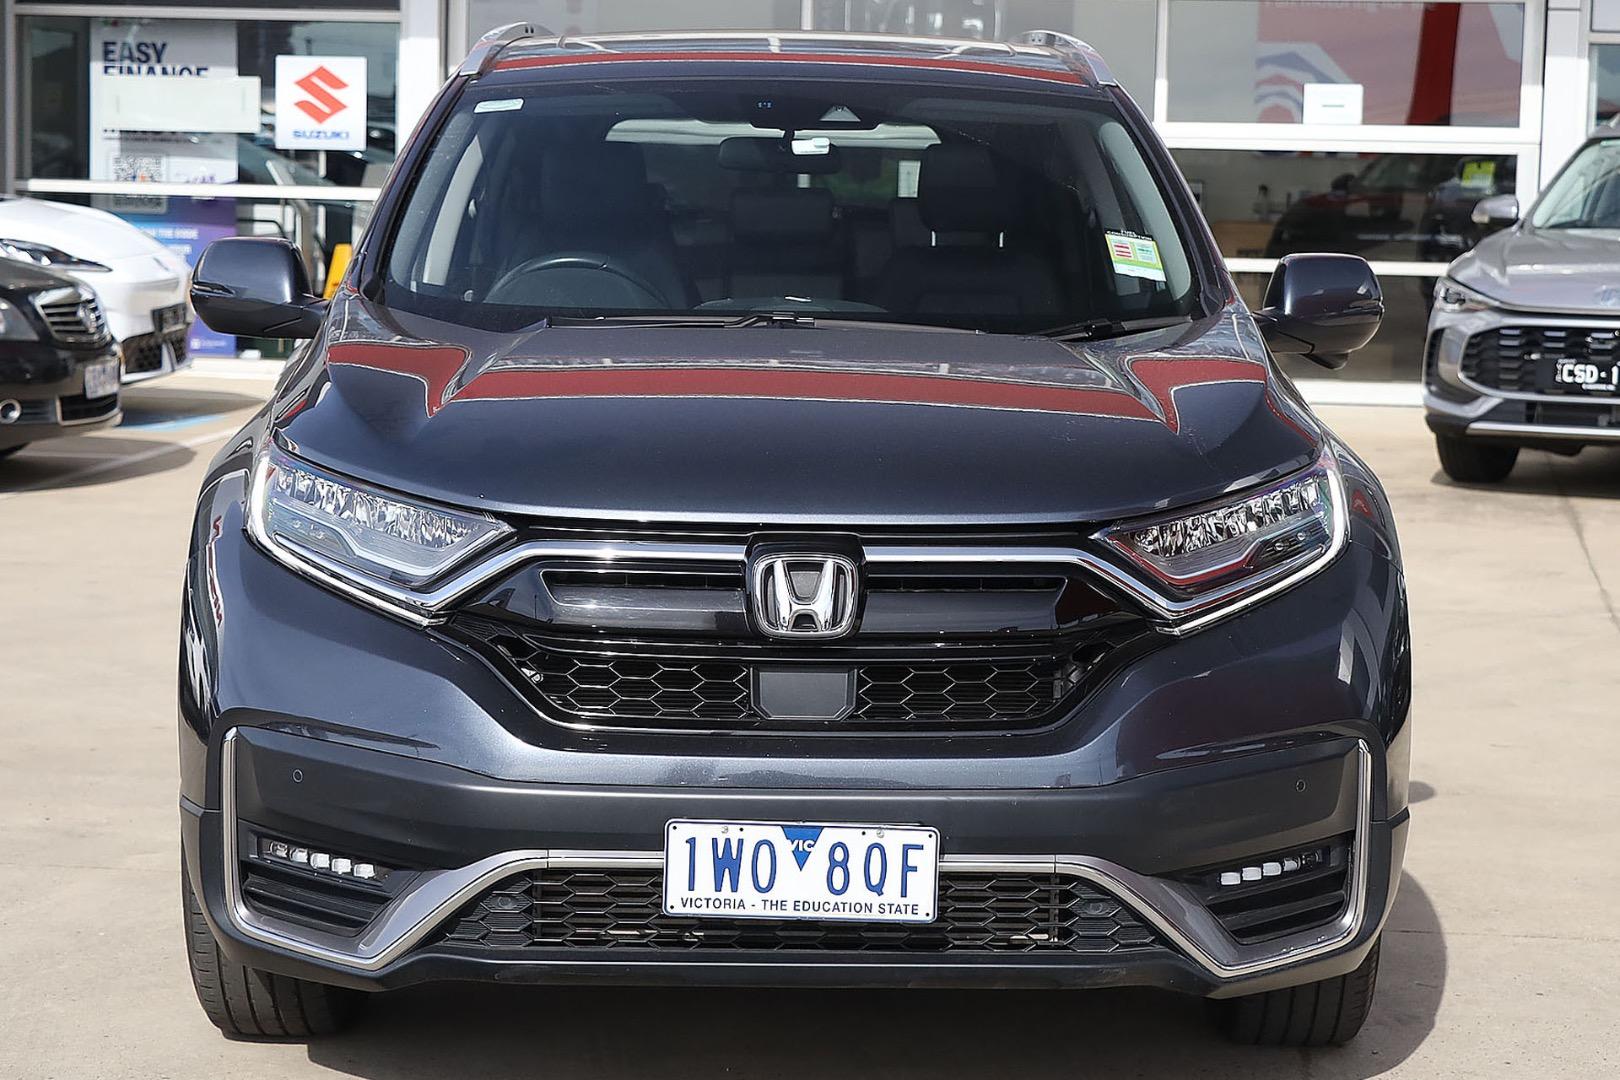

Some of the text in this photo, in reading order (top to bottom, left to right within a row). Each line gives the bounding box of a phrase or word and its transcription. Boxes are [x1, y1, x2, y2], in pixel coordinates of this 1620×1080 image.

[103, 41, 167, 64] EASY
[292, 130, 350, 140] SUZUKI
[685, 837, 924, 898] 1WO 8QF
[681, 897, 746, 911] VICTORIA
[761, 899, 788, 912] THE
[792, 900, 874, 914] EDUCATION
[877, 902, 919, 915] STATE
